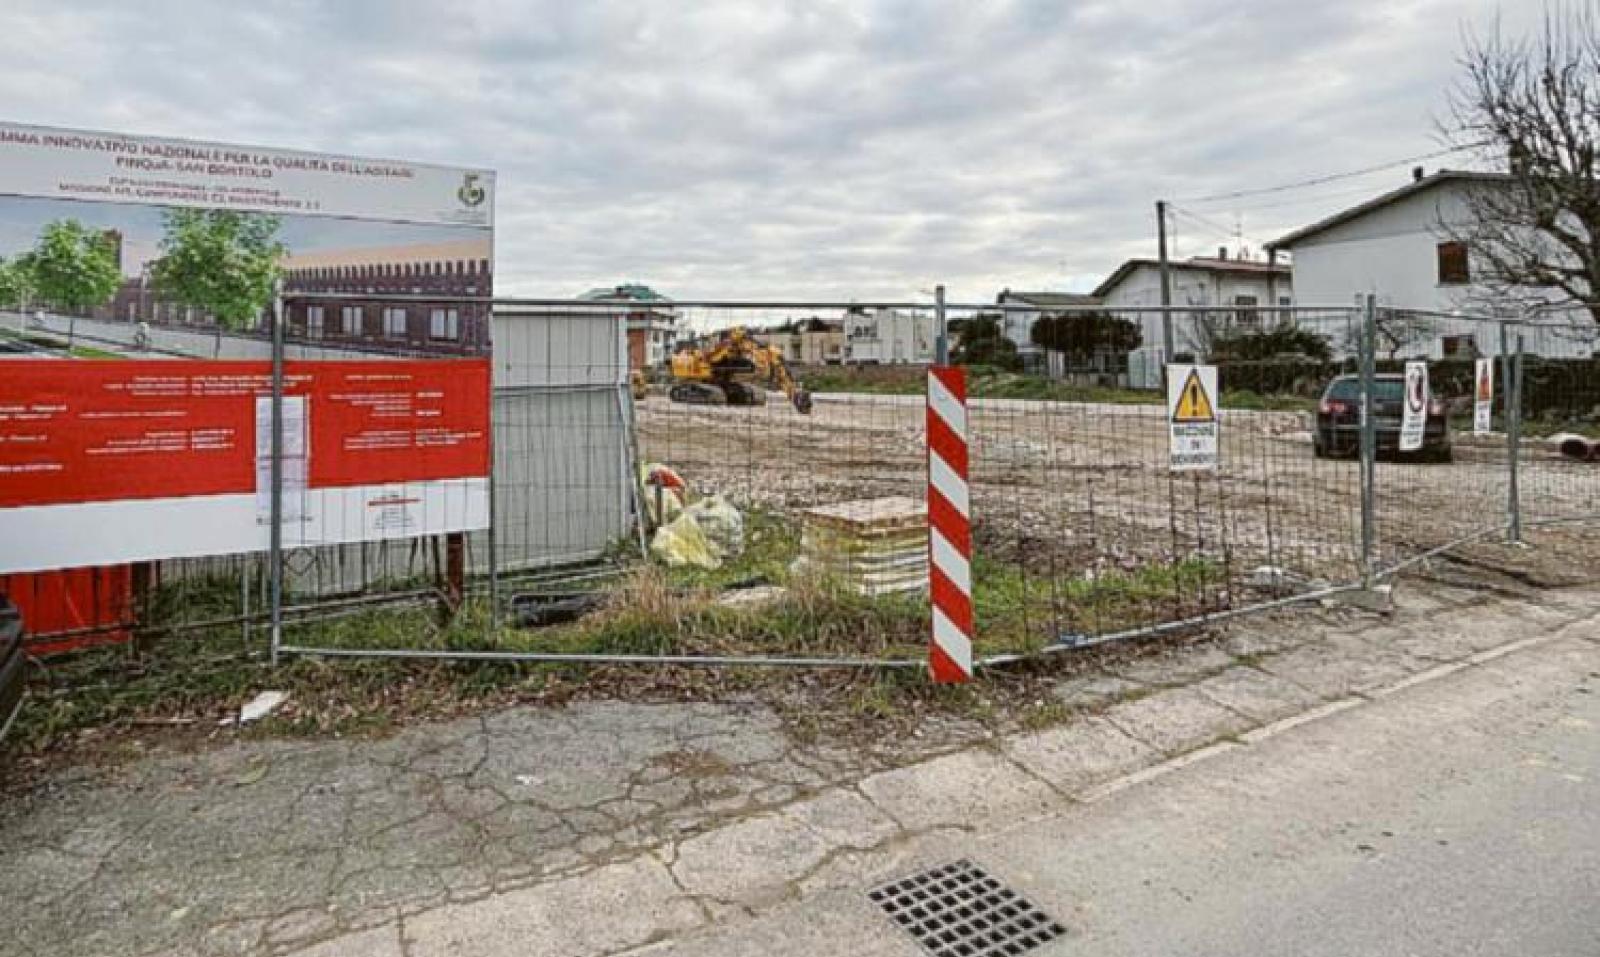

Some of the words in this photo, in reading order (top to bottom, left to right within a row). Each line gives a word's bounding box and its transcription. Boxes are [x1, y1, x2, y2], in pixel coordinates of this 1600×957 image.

[43, 136, 138, 154] INNOVATIVO
[142, 145, 219, 161] NAZIONALE
[223, 148, 250, 164] PER
[253, 153, 270, 165] LA
[208, 163, 272, 178] BORTOLO
